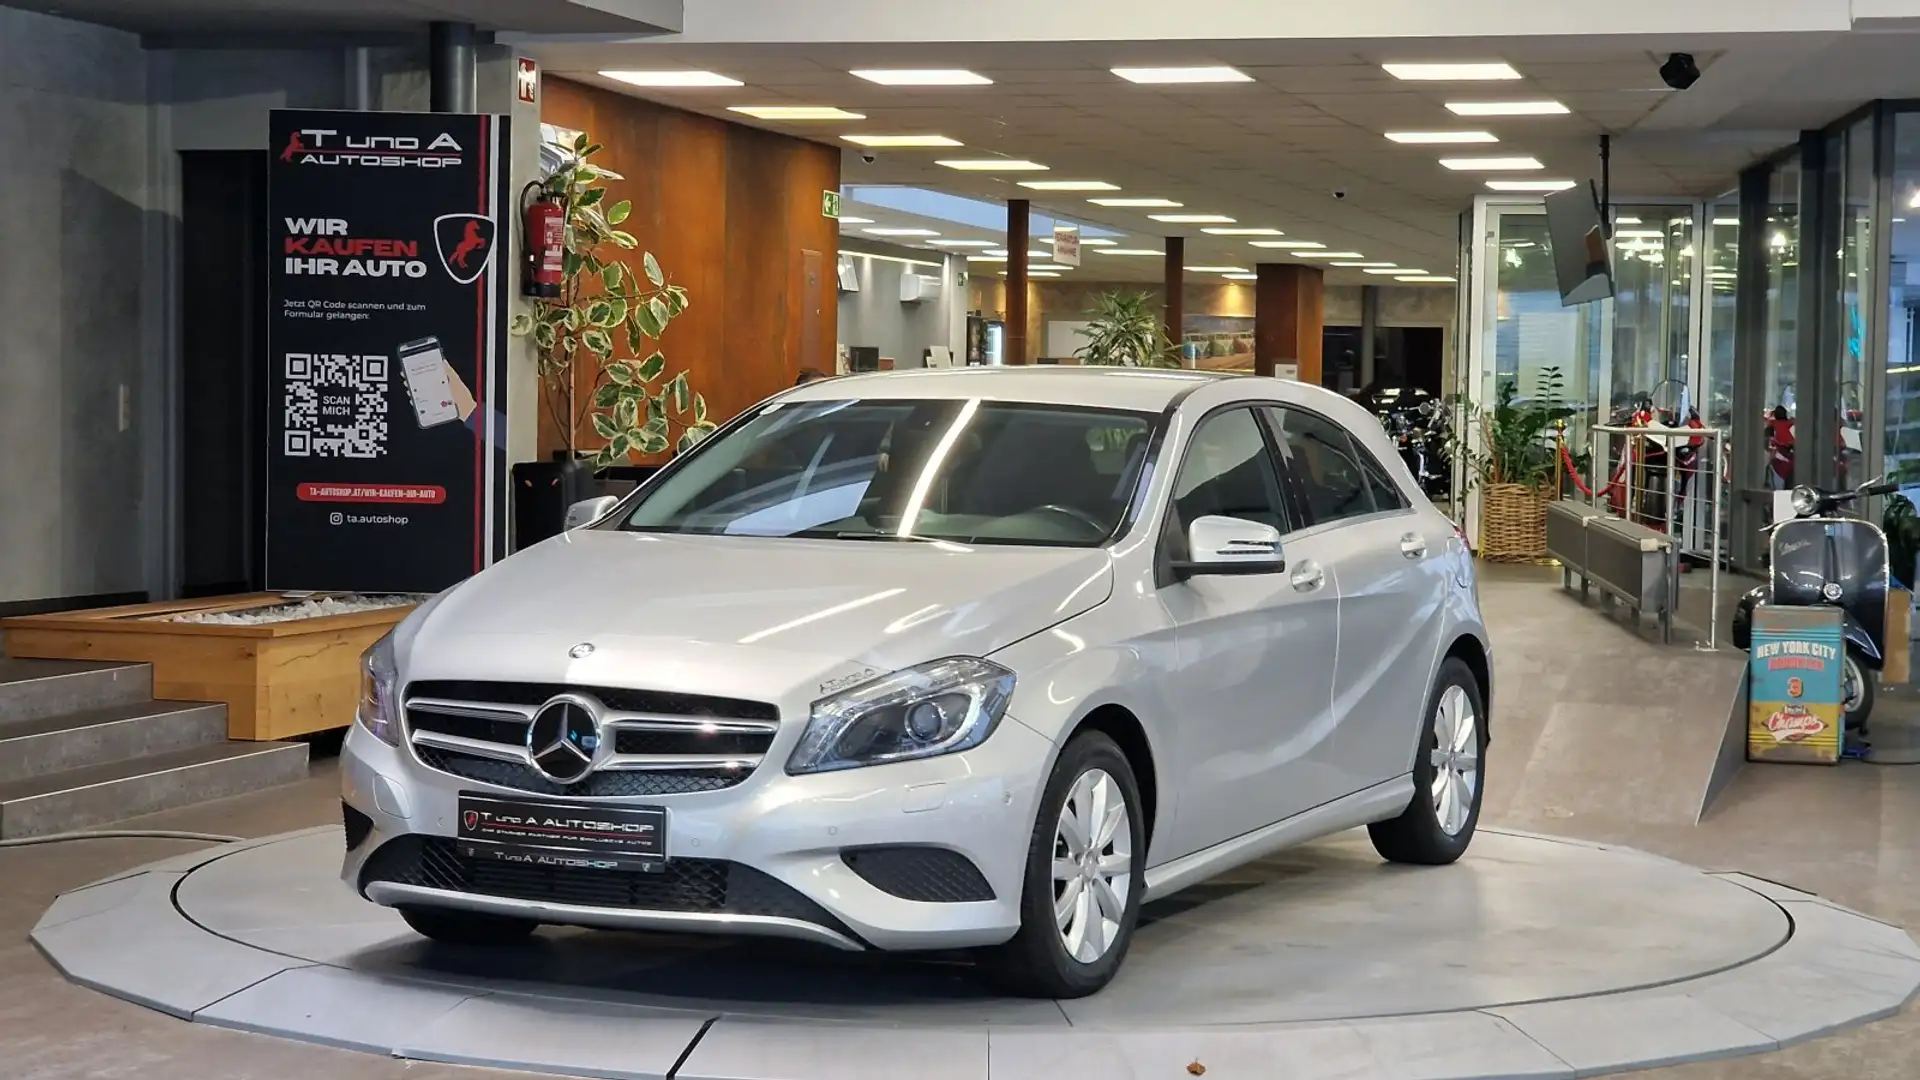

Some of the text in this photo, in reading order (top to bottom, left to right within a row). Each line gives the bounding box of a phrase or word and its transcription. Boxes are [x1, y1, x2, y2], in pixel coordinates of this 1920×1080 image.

[300, 129, 337, 147] T
[427, 132, 463, 151] A
[300, 154, 462, 168] AUTOSHOP
[284, 217, 348, 236] WIR
[284, 237, 418, 257] KAUFEN
[285, 258, 427, 278] IHR AUTO
[283, 299, 426, 311] Jetzt QR Code scannen und zum
[284, 309, 324, 318] Formular
[322, 395, 351, 405] SCAN
[322, 405, 351, 416] MICH
[346, 514, 409, 526] ta.autoshop
[1756, 640, 1837, 660] NEW YORK CITY
[480, 811, 493, 821] T
[525, 816, 538, 825] A
[543, 818, 654, 833] AUTOSHOP
[494, 851, 504, 860] T
[523, 854, 533, 863] A
[538, 856, 618, 868] AUTOSHOP
